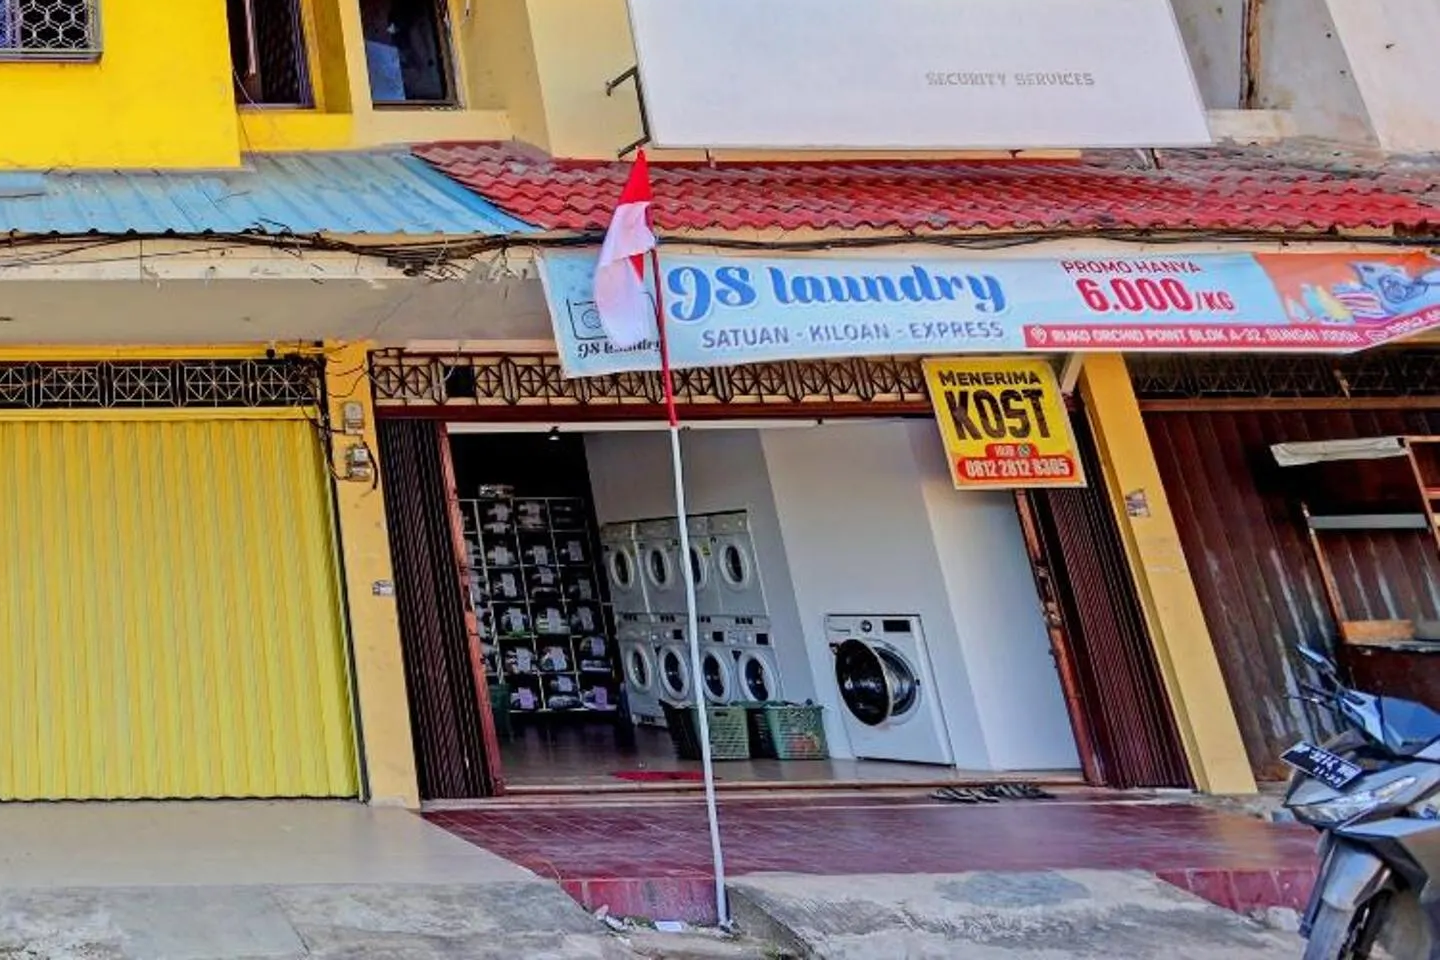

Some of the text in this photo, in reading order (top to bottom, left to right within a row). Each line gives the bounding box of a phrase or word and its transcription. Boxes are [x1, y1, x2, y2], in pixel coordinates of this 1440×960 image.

[925, 71, 1095, 86] SECURITY SERVICES
[1061, 260, 1202, 274] PROMO HANYA
[667, 264, 1006, 322] 98 laundry
[701, 325, 789, 349] SATUAN
[809, 321, 889, 341] KILOAN
[910, 320, 1005, 340] EXPRESS
[938, 370, 1042, 386] MENERIMA
[944, 388, 1050, 440] KOST
